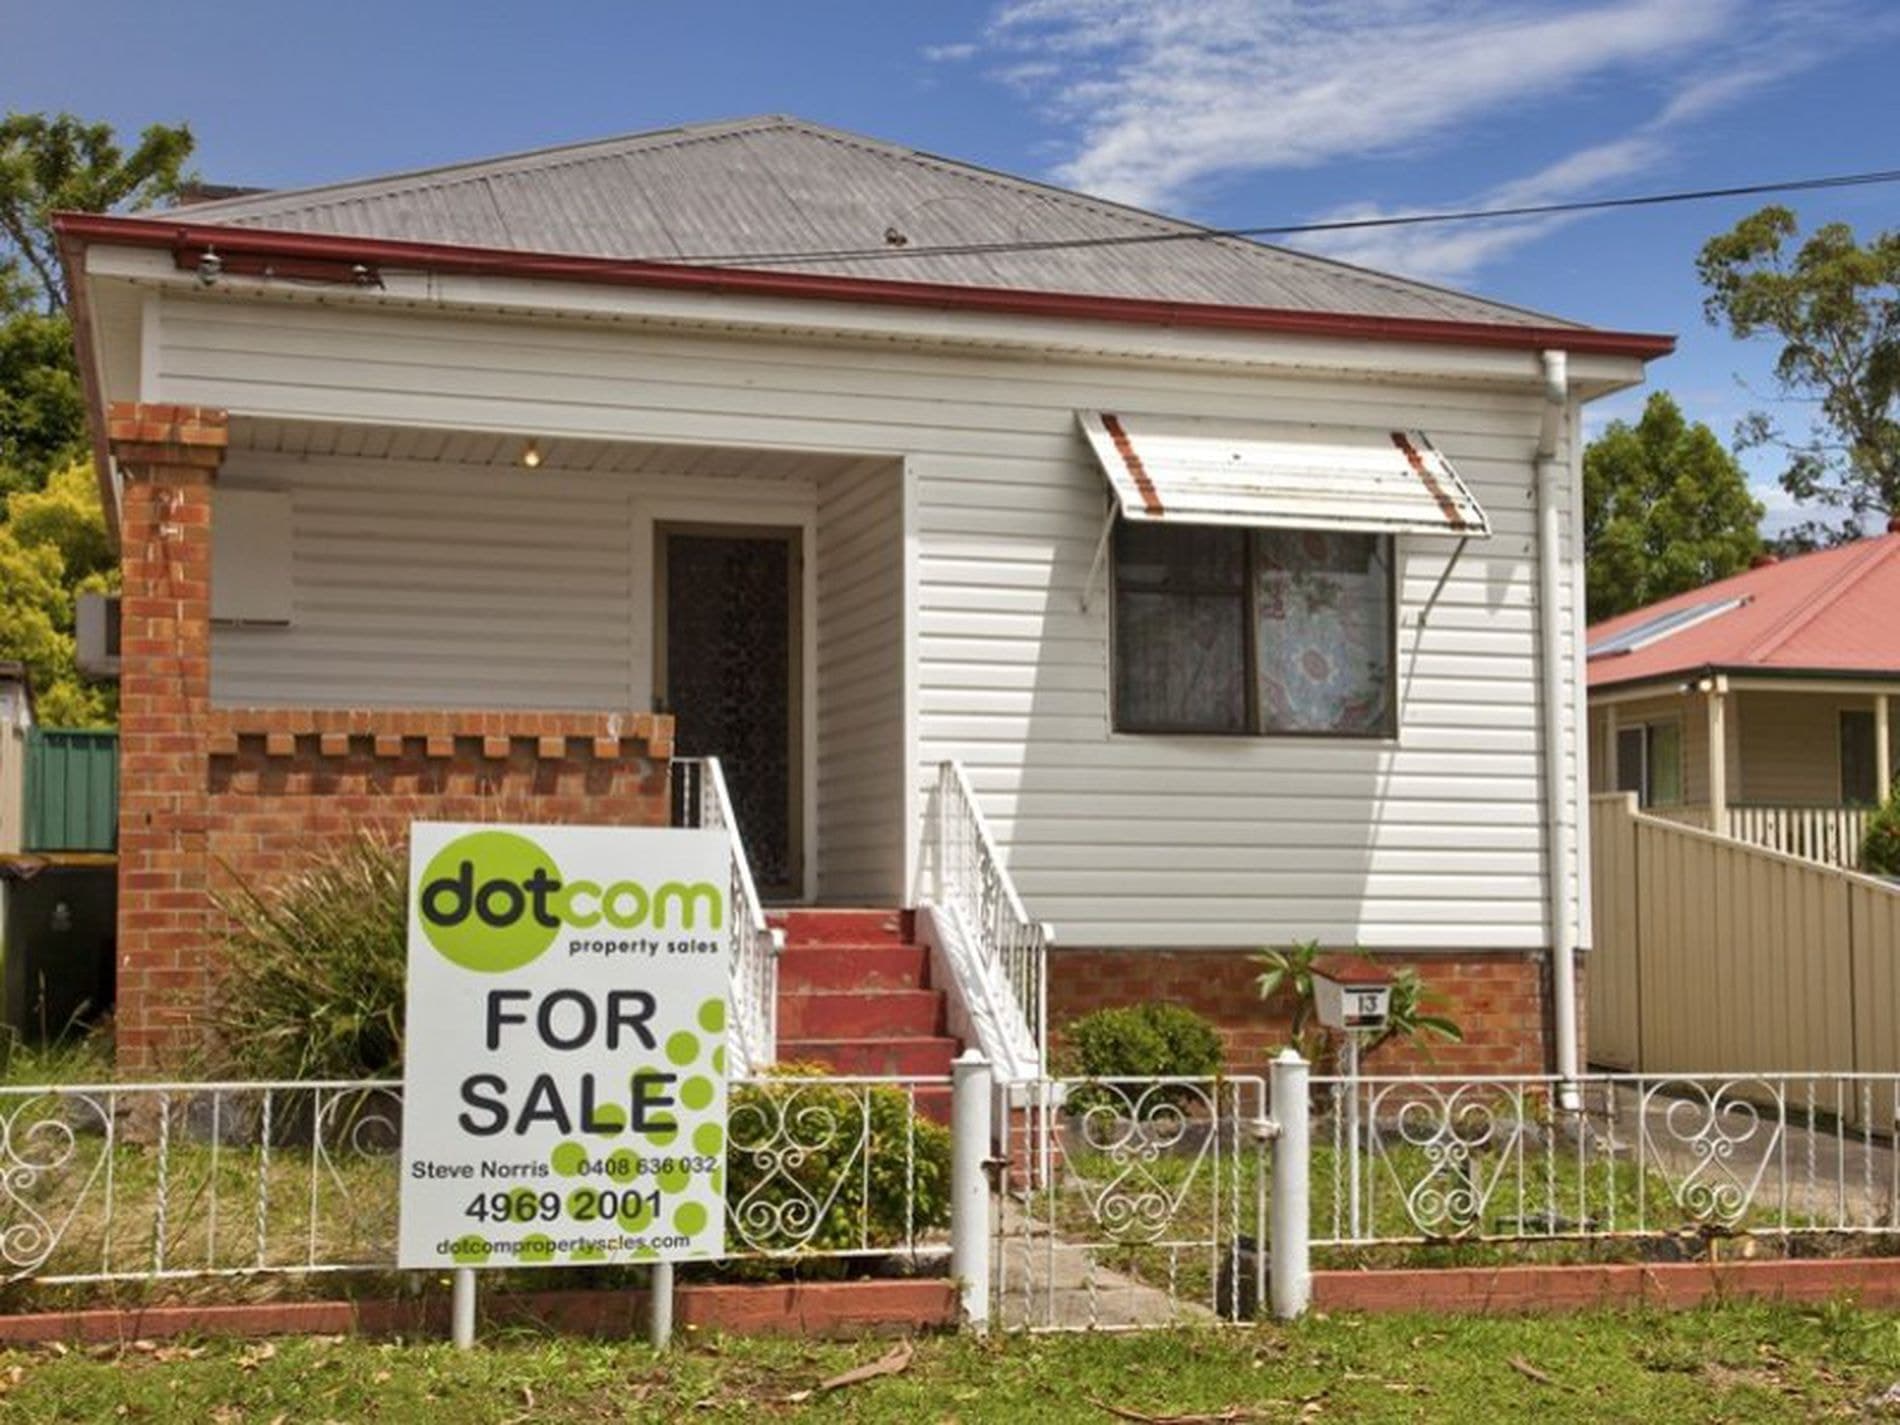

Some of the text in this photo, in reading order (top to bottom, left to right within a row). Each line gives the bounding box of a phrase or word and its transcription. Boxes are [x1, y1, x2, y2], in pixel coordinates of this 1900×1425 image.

[569, 938, 718, 957] property sales
[1358, 995, 1378, 1013] 13
[486, 988, 657, 1051] FOR
[458, 1073, 678, 1136] SALE
[411, 1155, 717, 1179] Steve Norris 0408 636 032
[465, 1189, 663, 1223] 4969 2001
